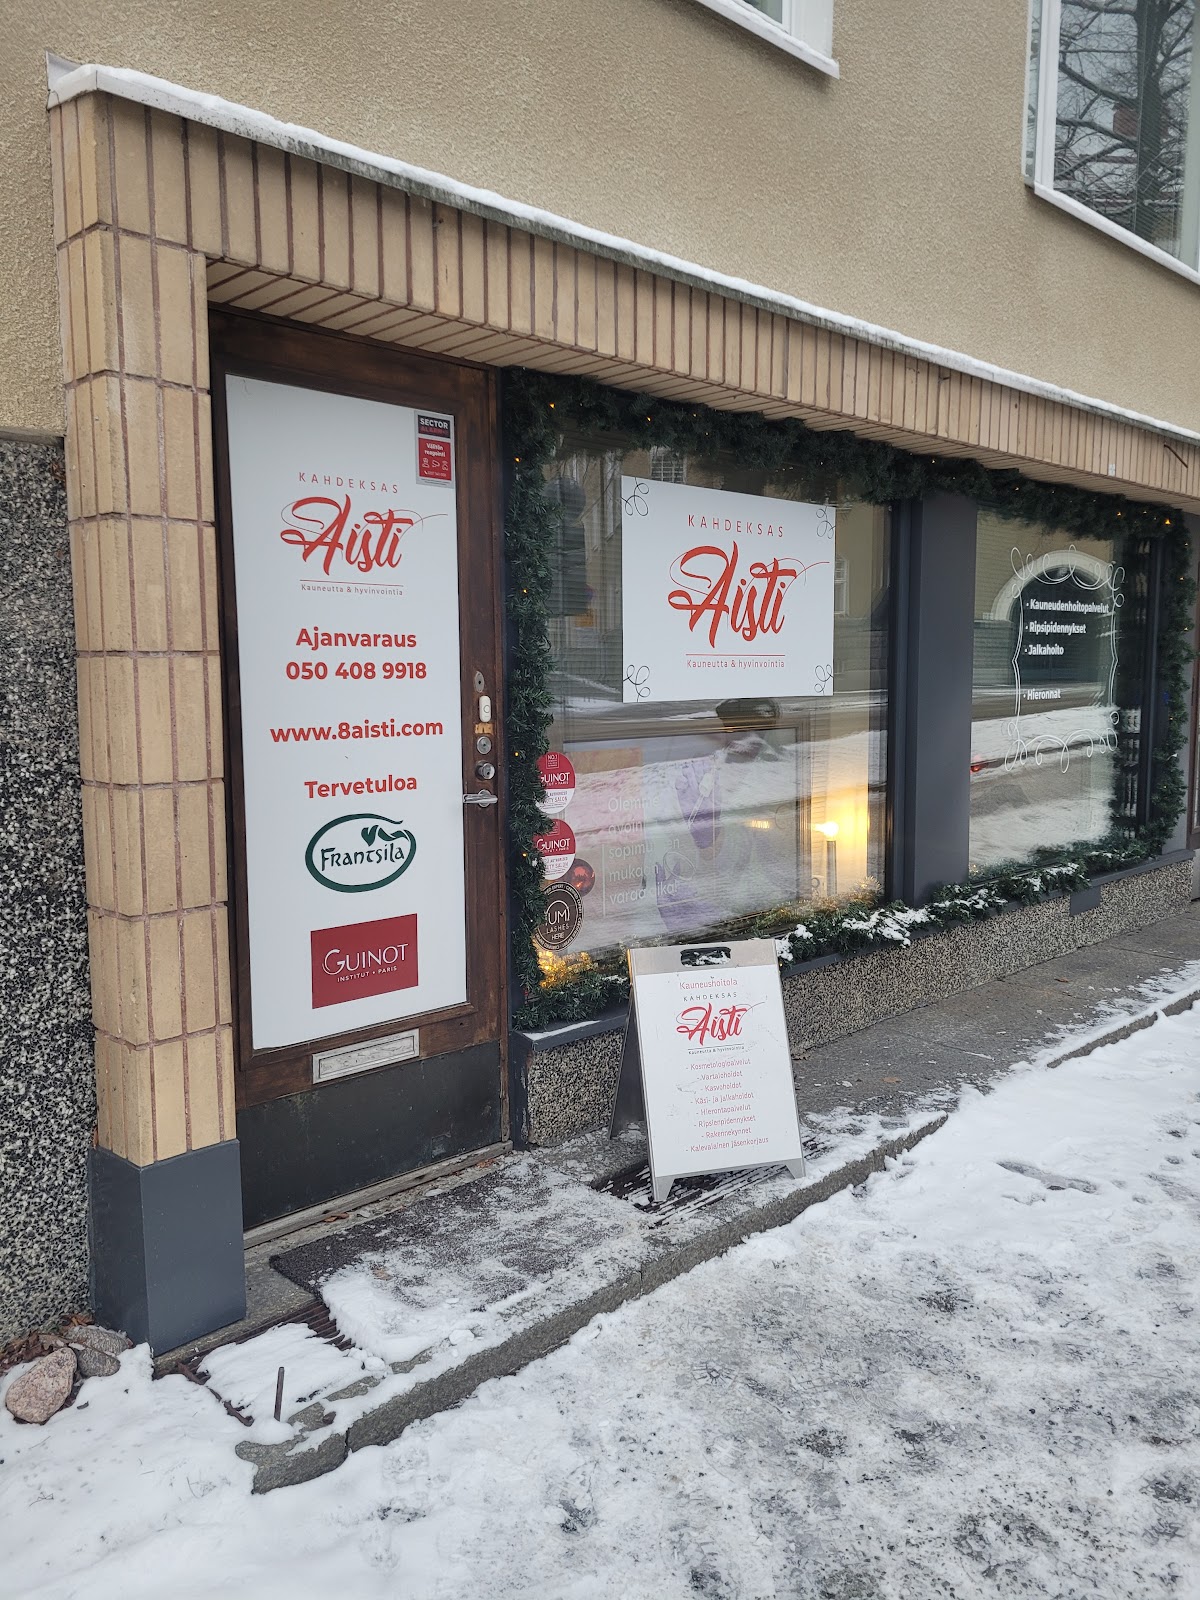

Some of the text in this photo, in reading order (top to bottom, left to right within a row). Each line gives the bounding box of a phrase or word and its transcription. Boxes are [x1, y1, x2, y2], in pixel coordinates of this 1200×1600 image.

[420, 418, 448, 429] SECTOR
[298, 472, 399, 494] KAHDEKSAS
[688, 514, 784, 538] KAHDEKSAS
[280, 494, 424, 576] Aisti
[301, 584, 344, 593] Kauneutta
[354, 586, 403, 596] hyvinvointia
[668, 540, 806, 648] Aisti
[1030, 598, 1109, 614] Kauneudenhoitopalvelut
[1029, 620, 1086, 635] Ripsipidennykset
[296, 626, 417, 652] Ajanvaraus
[1028, 643, 1064, 655] Jalkahoito
[286, 662, 427, 680] 050 408 9918
[687, 659, 785, 670] Kauneutta & hyvinvointia
[1027, 688, 1061, 700] Hieronnat
[270, 718, 444, 742] www.8aisti.com
[304, 774, 418, 799] Tervetuloa
[320, 842, 405, 872] Frantsila
[547, 923, 570, 934] LASHES
[552, 932, 565, 940] HERE
[322, 943, 408, 976] GUINOT
[337, 966, 397, 983] INSTITUT PARIS
[680, 978, 738, 990] Kauneushoitola
[683, 992, 737, 1002] KAHDEKSAS
[676, 1002, 752, 1046] Aisti
[701, 1070, 743, 1080] Vartalohoidot
[704, 1082, 742, 1092] Kasvohoidot
[695, 1096, 711, 1105] Käsi-
[720, 1092, 754, 1103] jalkahoidot
[706, 1127, 751, 1138] Rakennekynnet
